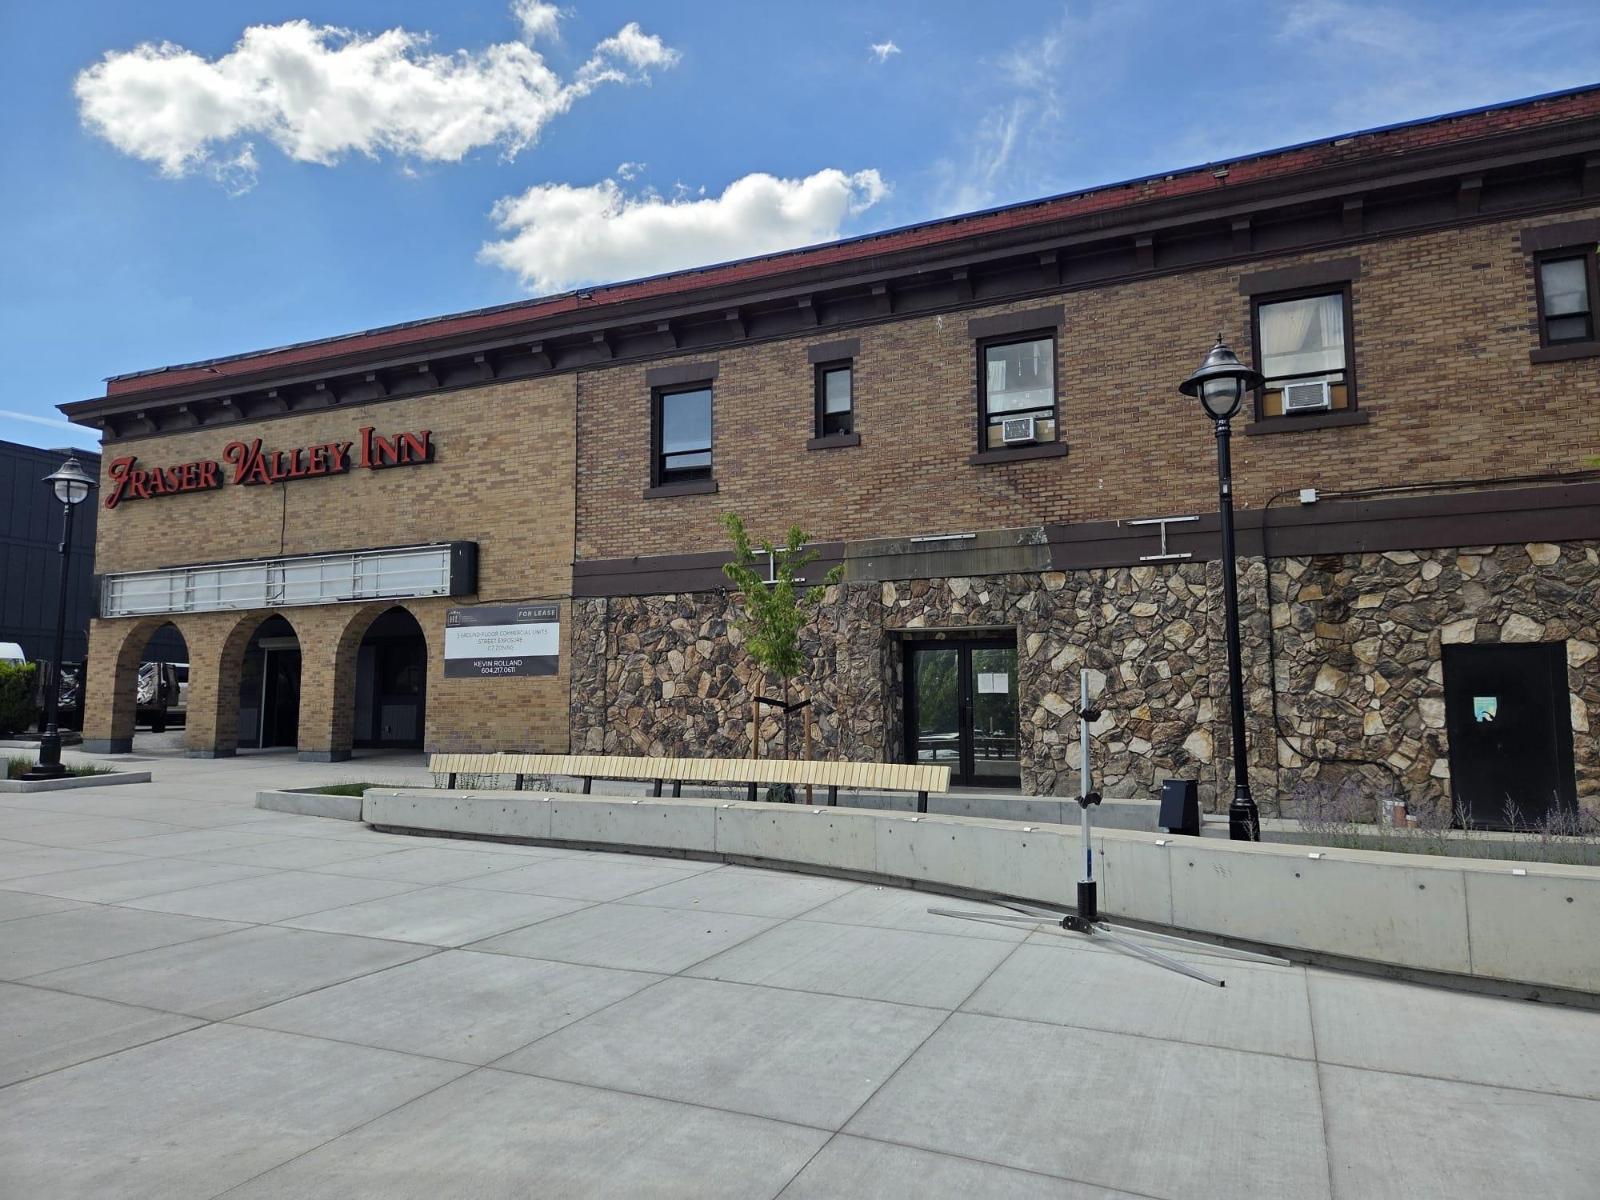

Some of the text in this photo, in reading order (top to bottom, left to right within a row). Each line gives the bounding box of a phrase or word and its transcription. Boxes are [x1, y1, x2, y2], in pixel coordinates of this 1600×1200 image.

[104, 426, 432, 509] FRASER VALLEY INN
[533, 609, 556, 617] LEASE
[473, 659, 523, 668] KEVIN ROLLAND
